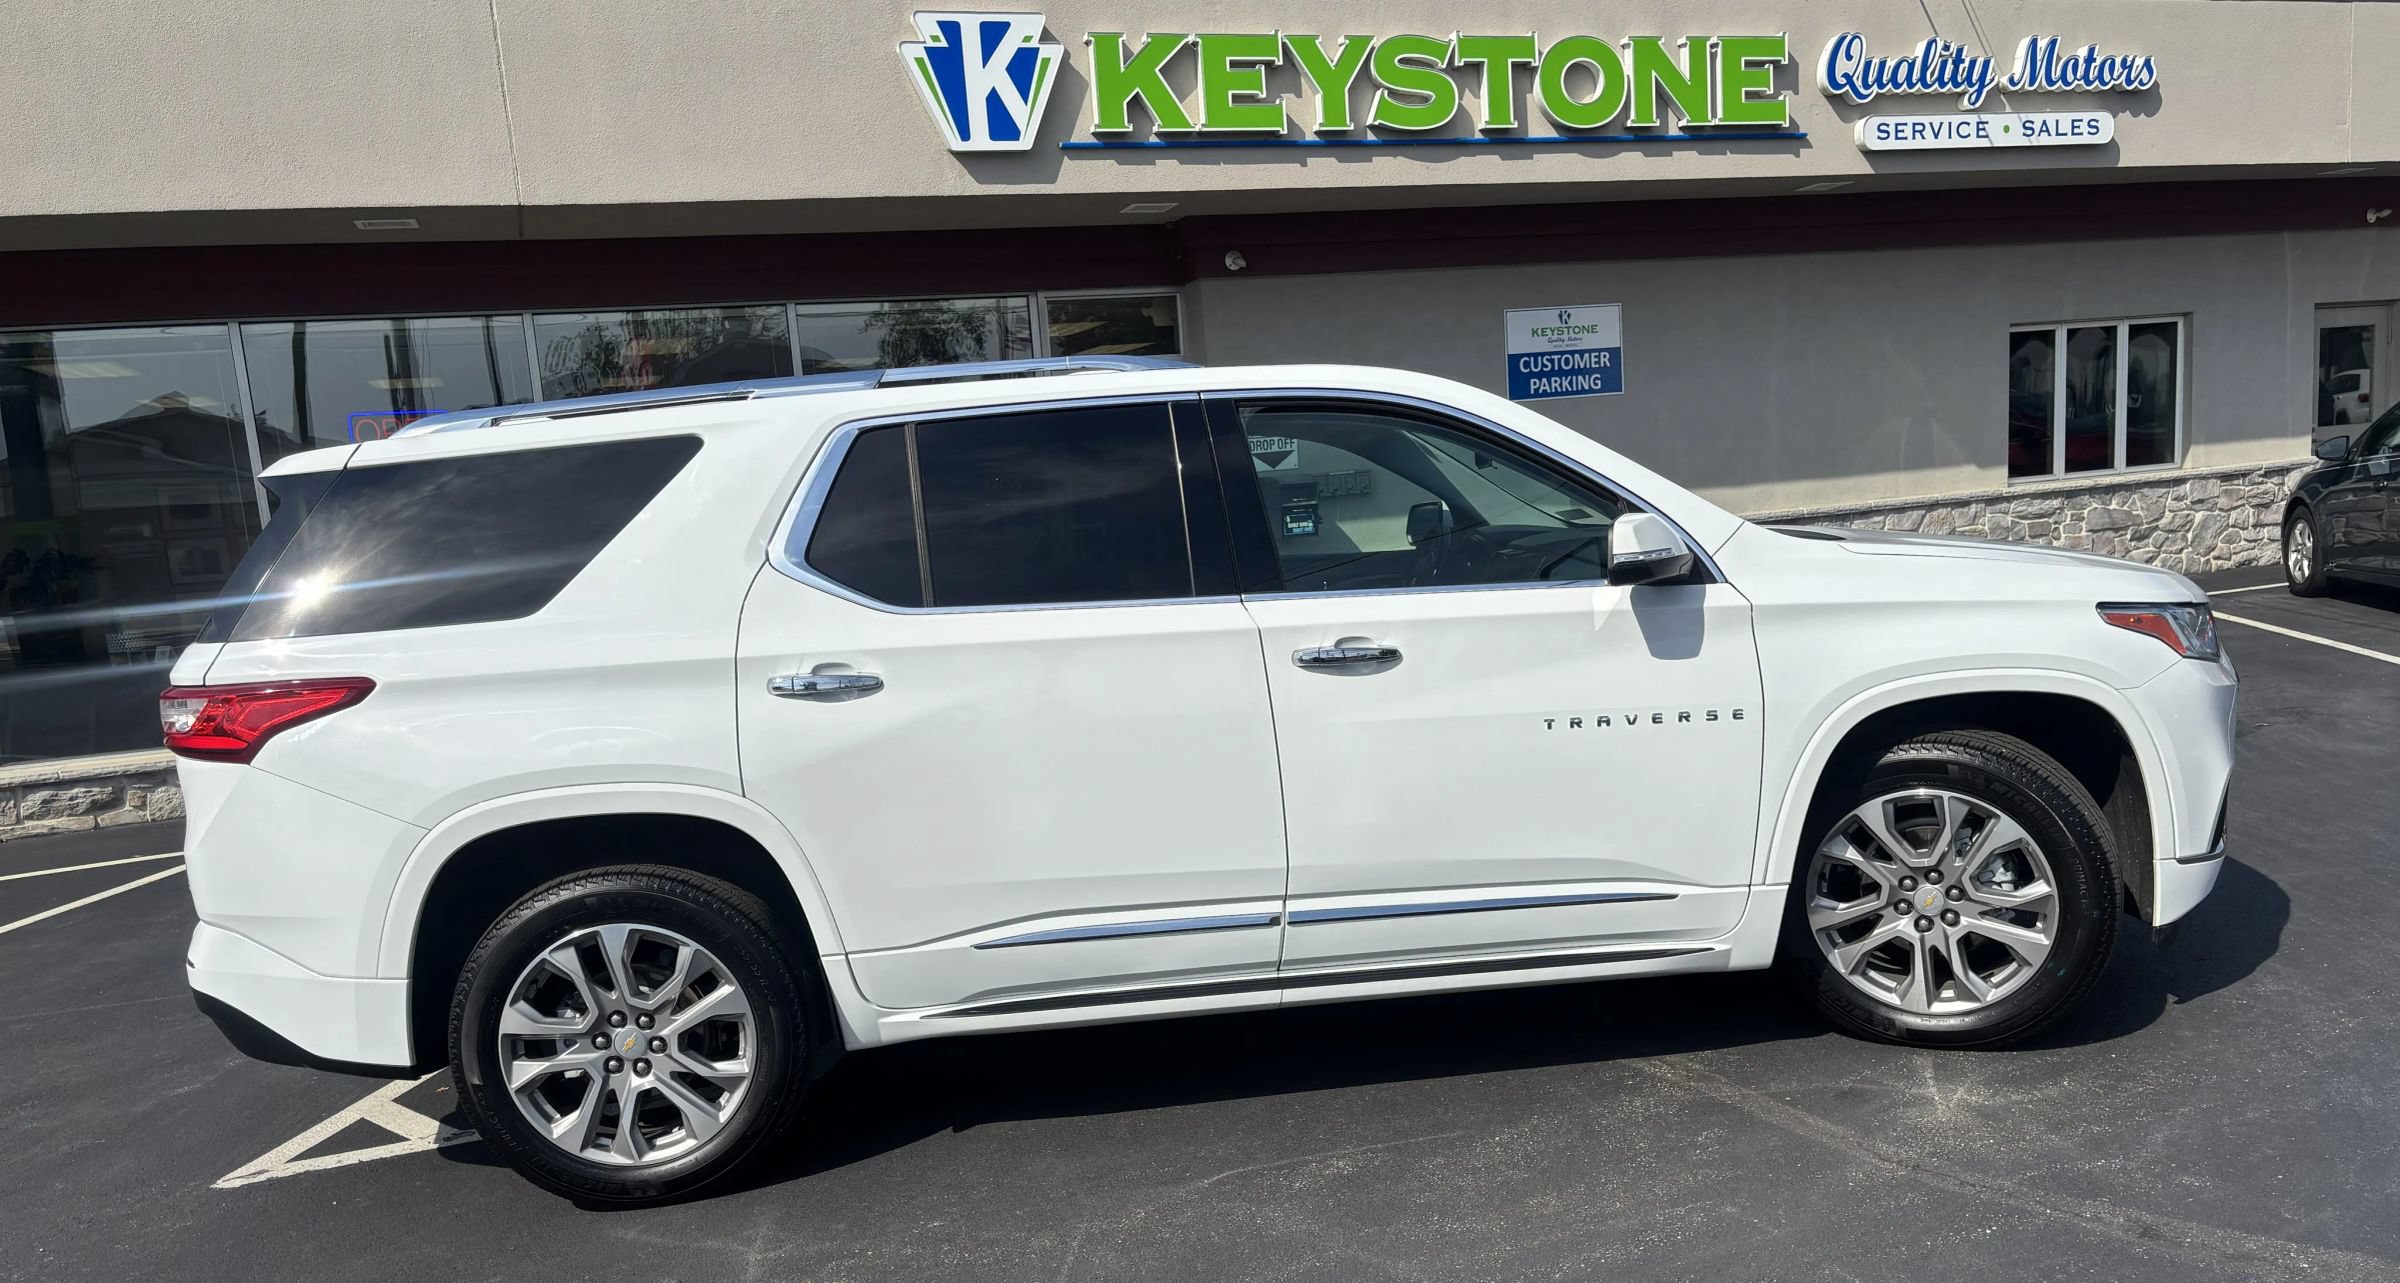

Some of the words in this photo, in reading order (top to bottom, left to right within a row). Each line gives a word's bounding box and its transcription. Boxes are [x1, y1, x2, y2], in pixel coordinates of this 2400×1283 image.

[1820, 31, 1997, 109] Quality
[2006, 33, 2157, 93] Motors
[1084, 29, 1789, 136] KEYSTONE
[1875, 119, 1990, 142] SERVICE
[2021, 117, 2101, 138] SALES
[1531, 324, 1599, 338] KEYSTONE
[1519, 351, 1611, 373] CUSTOMER
[1529, 373, 1602, 395] PARKING
[1250, 439, 1276, 452] DROP
[1277, 437, 1296, 450] OFF
[1543, 708, 1745, 731] TRAVERSE
